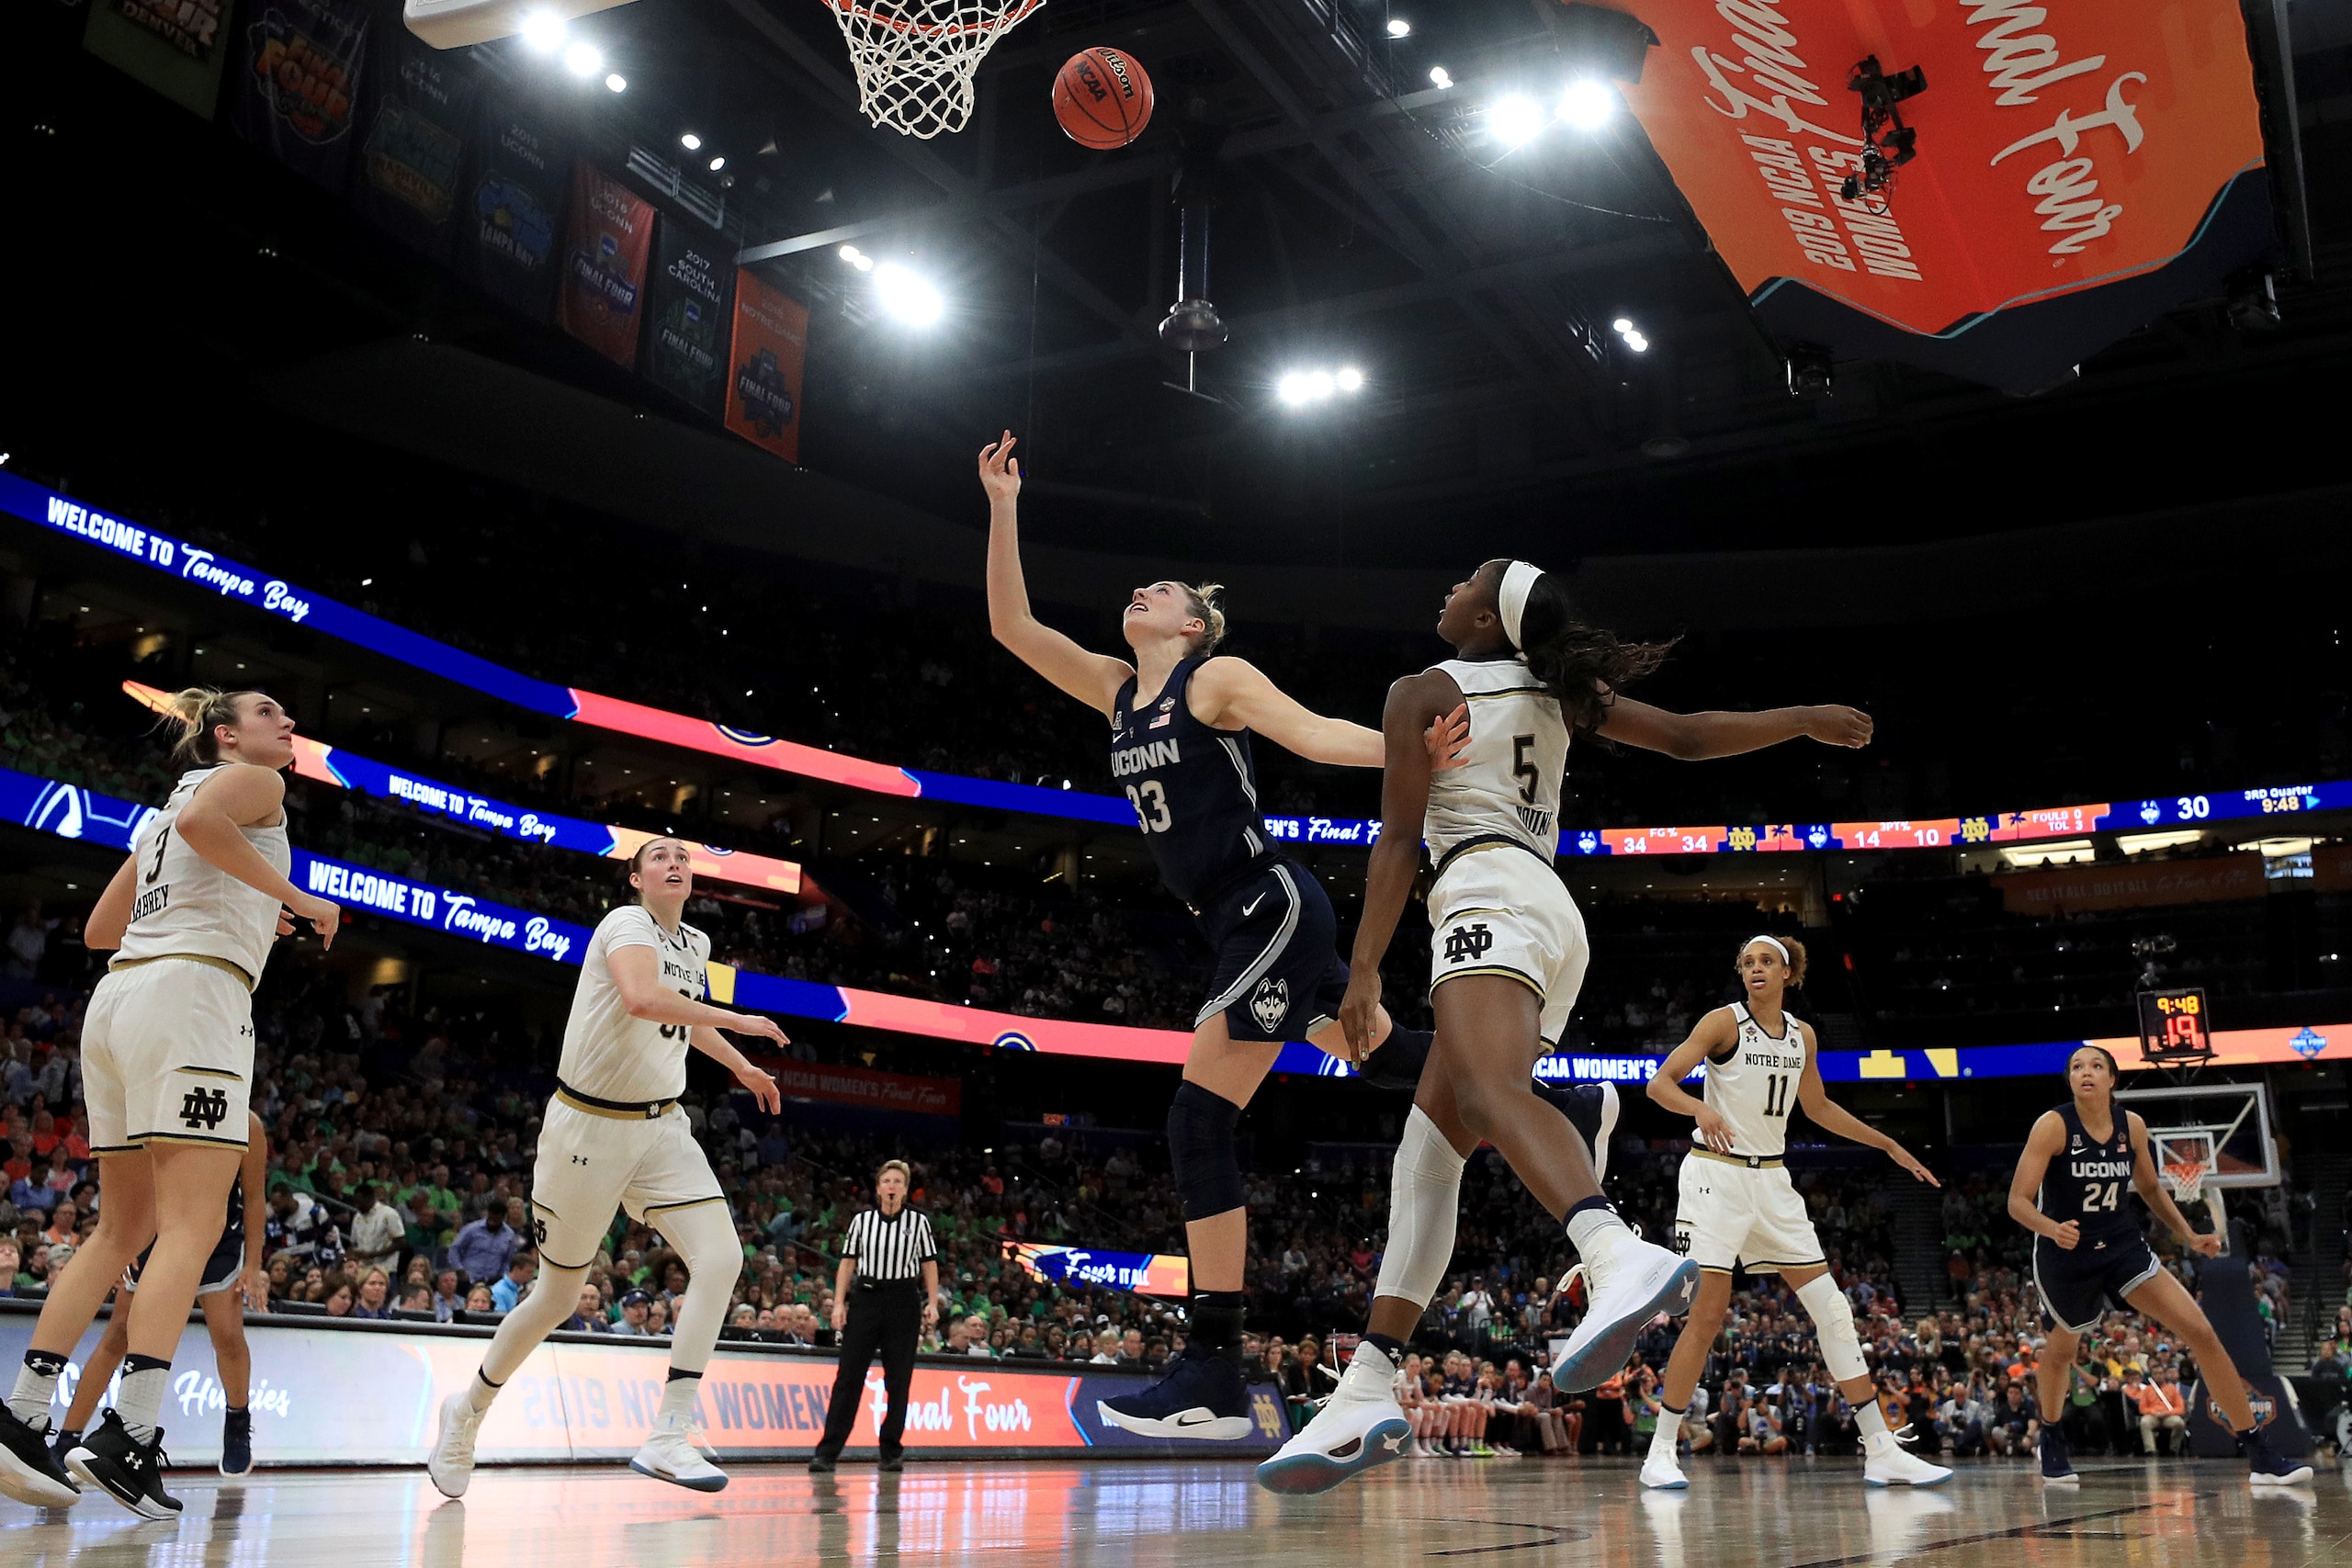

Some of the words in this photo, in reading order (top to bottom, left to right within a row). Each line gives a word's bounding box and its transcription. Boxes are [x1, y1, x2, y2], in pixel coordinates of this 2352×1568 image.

[1075, 60, 1108, 102] NCAA
[1096, 48, 1135, 100] Wilson
[501, 133, 545, 170] UCONN
[1990, 72, 2147, 256] Four
[1741, 134, 1824, 209] NCAA
[1781, 208, 1857, 272] 2019
[677, 258, 716, 290] SOUTH
[685, 249, 711, 271] 2017
[604, 277, 634, 308] FOUR
[668, 265, 721, 306] CAROLINA
[48, 497, 147, 557] WELCOME
[149, 536, 175, 566] TO
[181, 543, 254, 595] Tampa
[264, 580, 311, 623] Bay
[1111, 738, 1182, 778] UCONN
[1512, 734, 1539, 806] 5
[1125, 780, 1172, 835] 33
[2177, 795, 2210, 819] 30
[2262, 795, 2300, 813] 9:48
[2269, 785, 2313, 798] Quarter
[389, 774, 447, 809] WELCOME
[448, 793, 465, 814] TO
[468, 795, 514, 829] Tampa
[519, 814, 556, 844] Bay
[2074, 808, 2082, 819] 0
[1307, 817, 1362, 841] Final
[1649, 828, 1666, 838] FG
[1854, 830, 1881, 847] 14
[1914, 829, 1939, 846] 10
[2048, 821, 2069, 832] TOL
[2075, 820, 2084, 831] 3
[145, 824, 172, 886] 3
[1623, 838, 1647, 853] 34
[1681, 836, 1708, 852] 34
[309, 860, 408, 914] WELCOME
[412, 887, 435, 920] TO
[443, 890, 516, 943] Tampa
[524, 917, 571, 962] Bay
[2157, 995, 2199, 1014] 9:48
[2166, 1015, 2197, 1047] 19
[1573, 1058, 1657, 1080] WOMEN'S
[1746, 1054, 1779, 1067] NOTRE
[1783, 1056, 1802, 1069] DAME
[784, 1069, 817, 1089] NCAA
[820, 1073, 879, 1098] WOMEN'S
[879, 1081, 914, 1100] Final
[1763, 1074, 1789, 1117] 11
[2071, 1161, 2132, 1179] UCONN
[2082, 1182, 2120, 1213] 24
[1065, 1247, 1116, 1284] Four
[1118, 1268, 1131, 1284] IT
[1131, 1269, 1150, 1286] ALL
[520, 1375, 610, 1428] 2019
[958, 1375, 1032, 1441] Four
